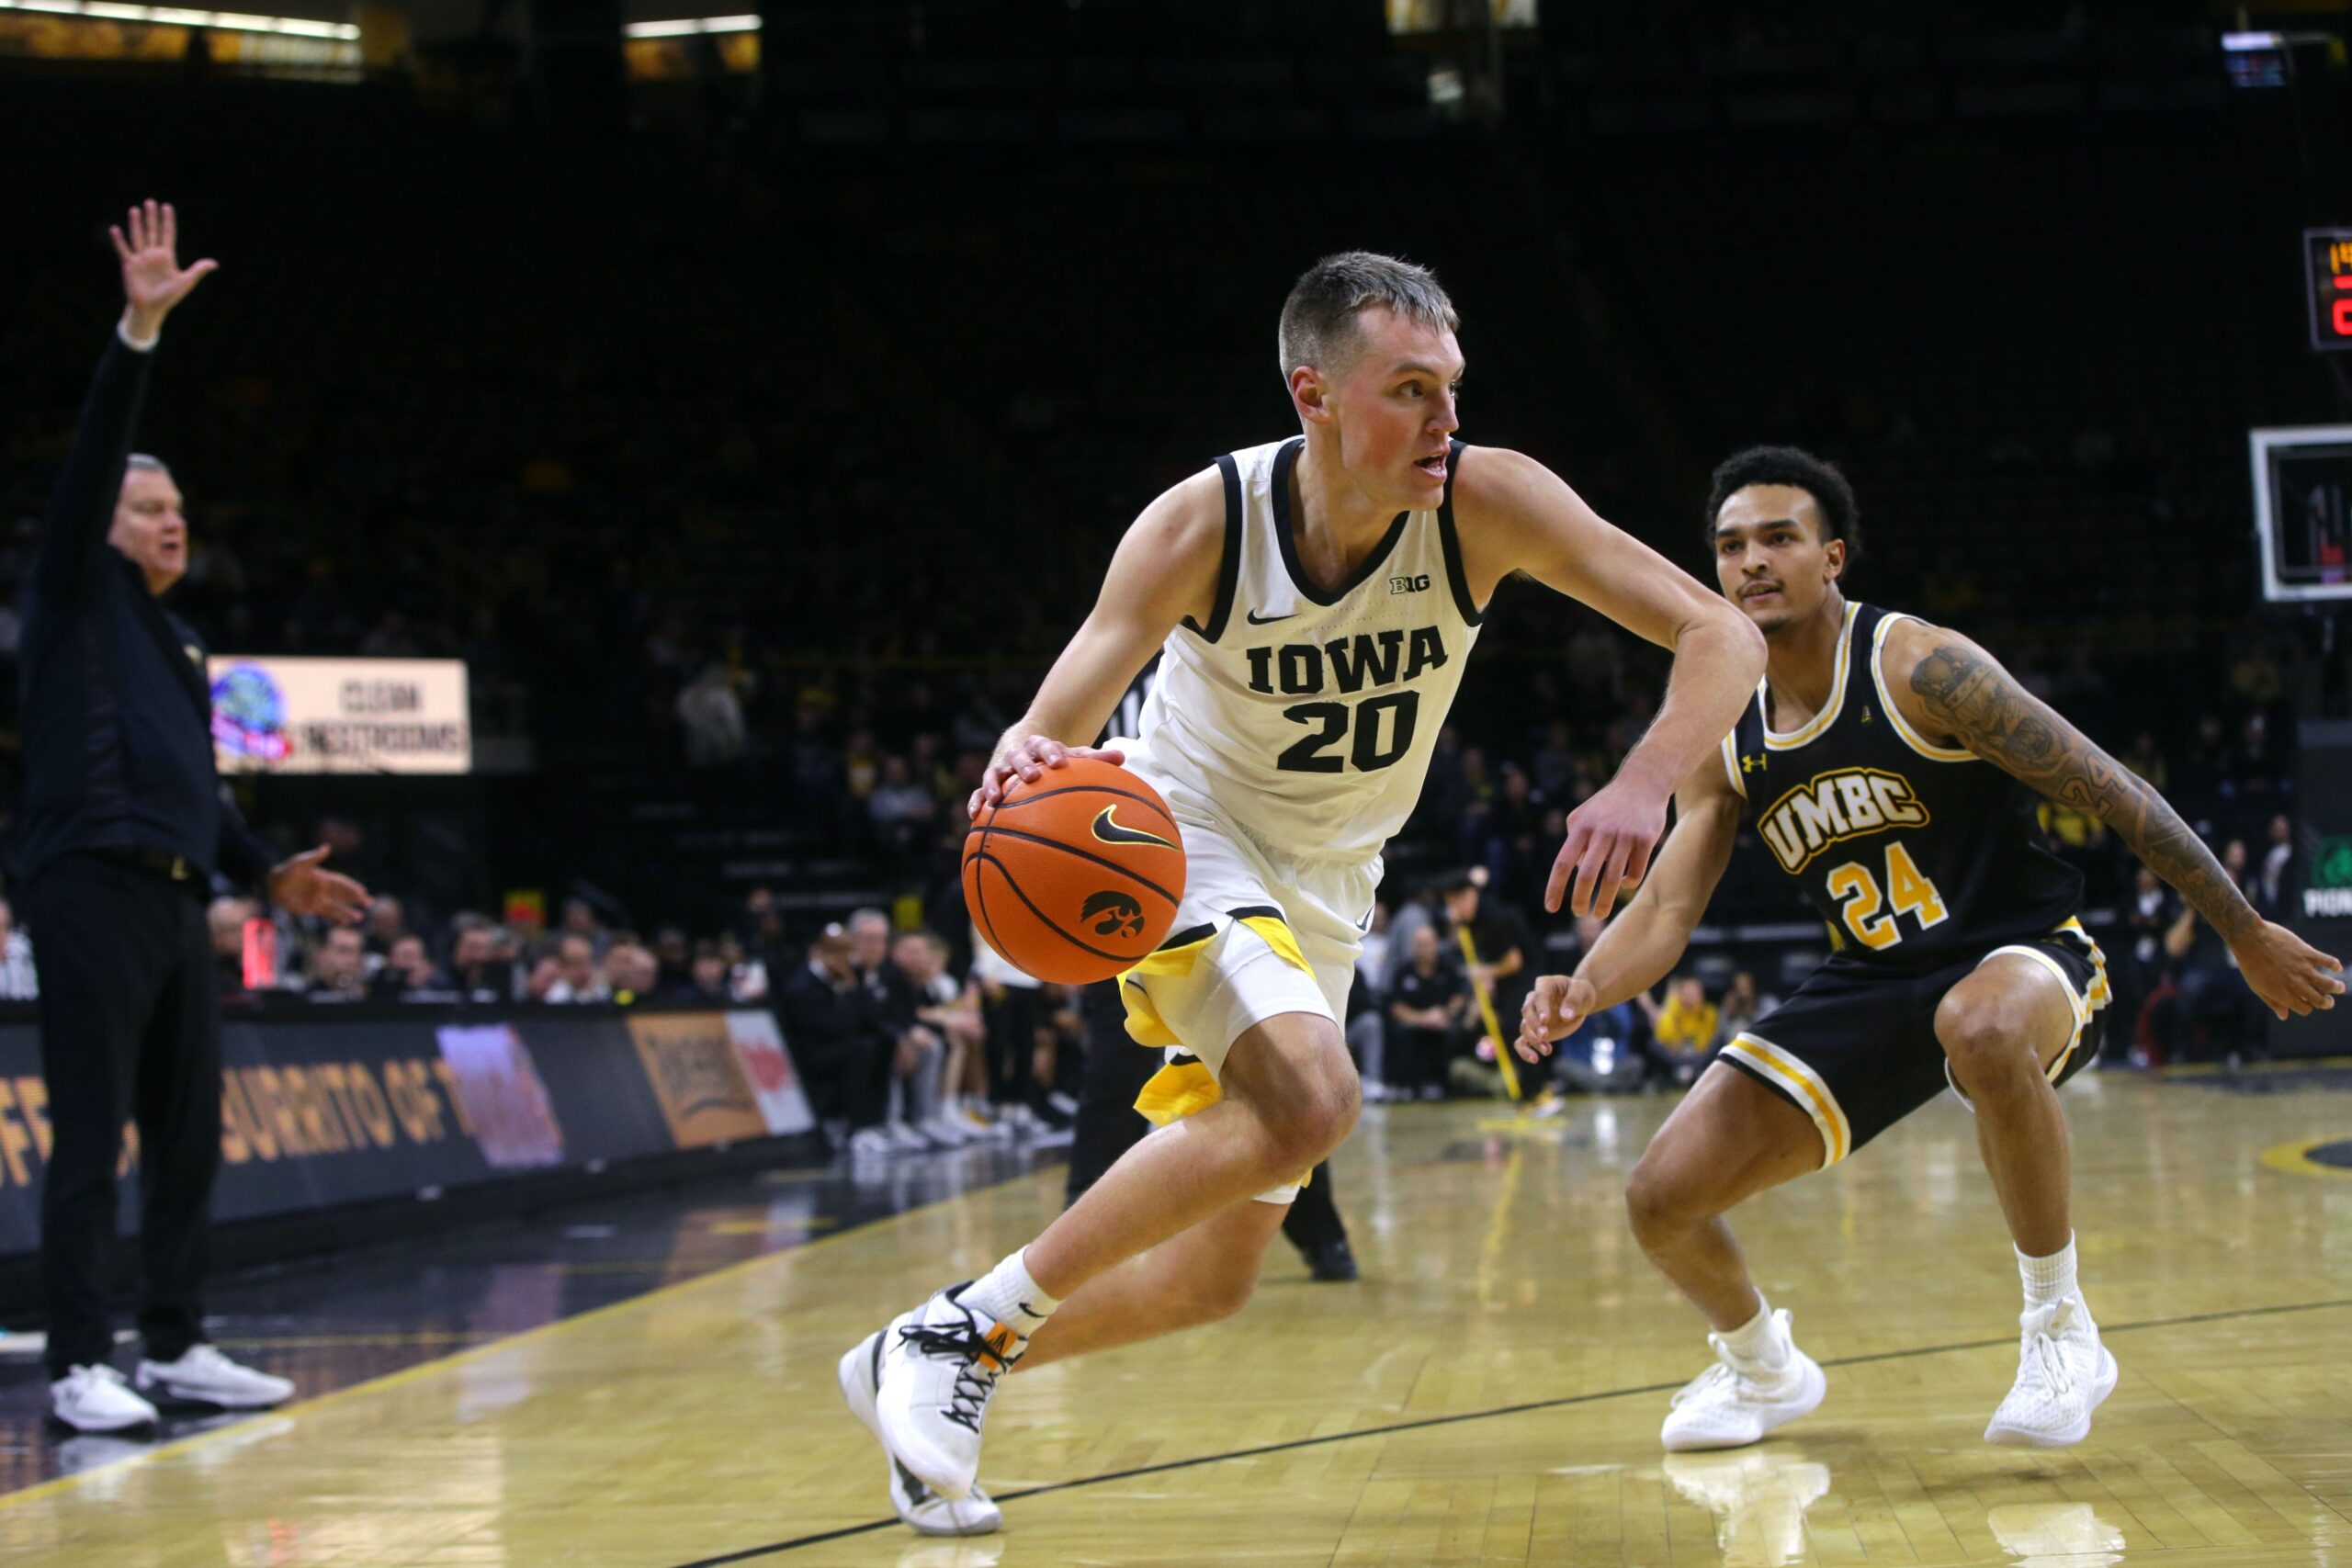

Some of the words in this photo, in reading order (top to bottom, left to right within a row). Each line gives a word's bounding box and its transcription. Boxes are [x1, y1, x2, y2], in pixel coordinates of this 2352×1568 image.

[1246, 625, 1449, 695] IOWA
[1276, 689, 1420, 773] 20
[1758, 768, 1928, 874] UMBC
[1826, 840, 1950, 951] 24
